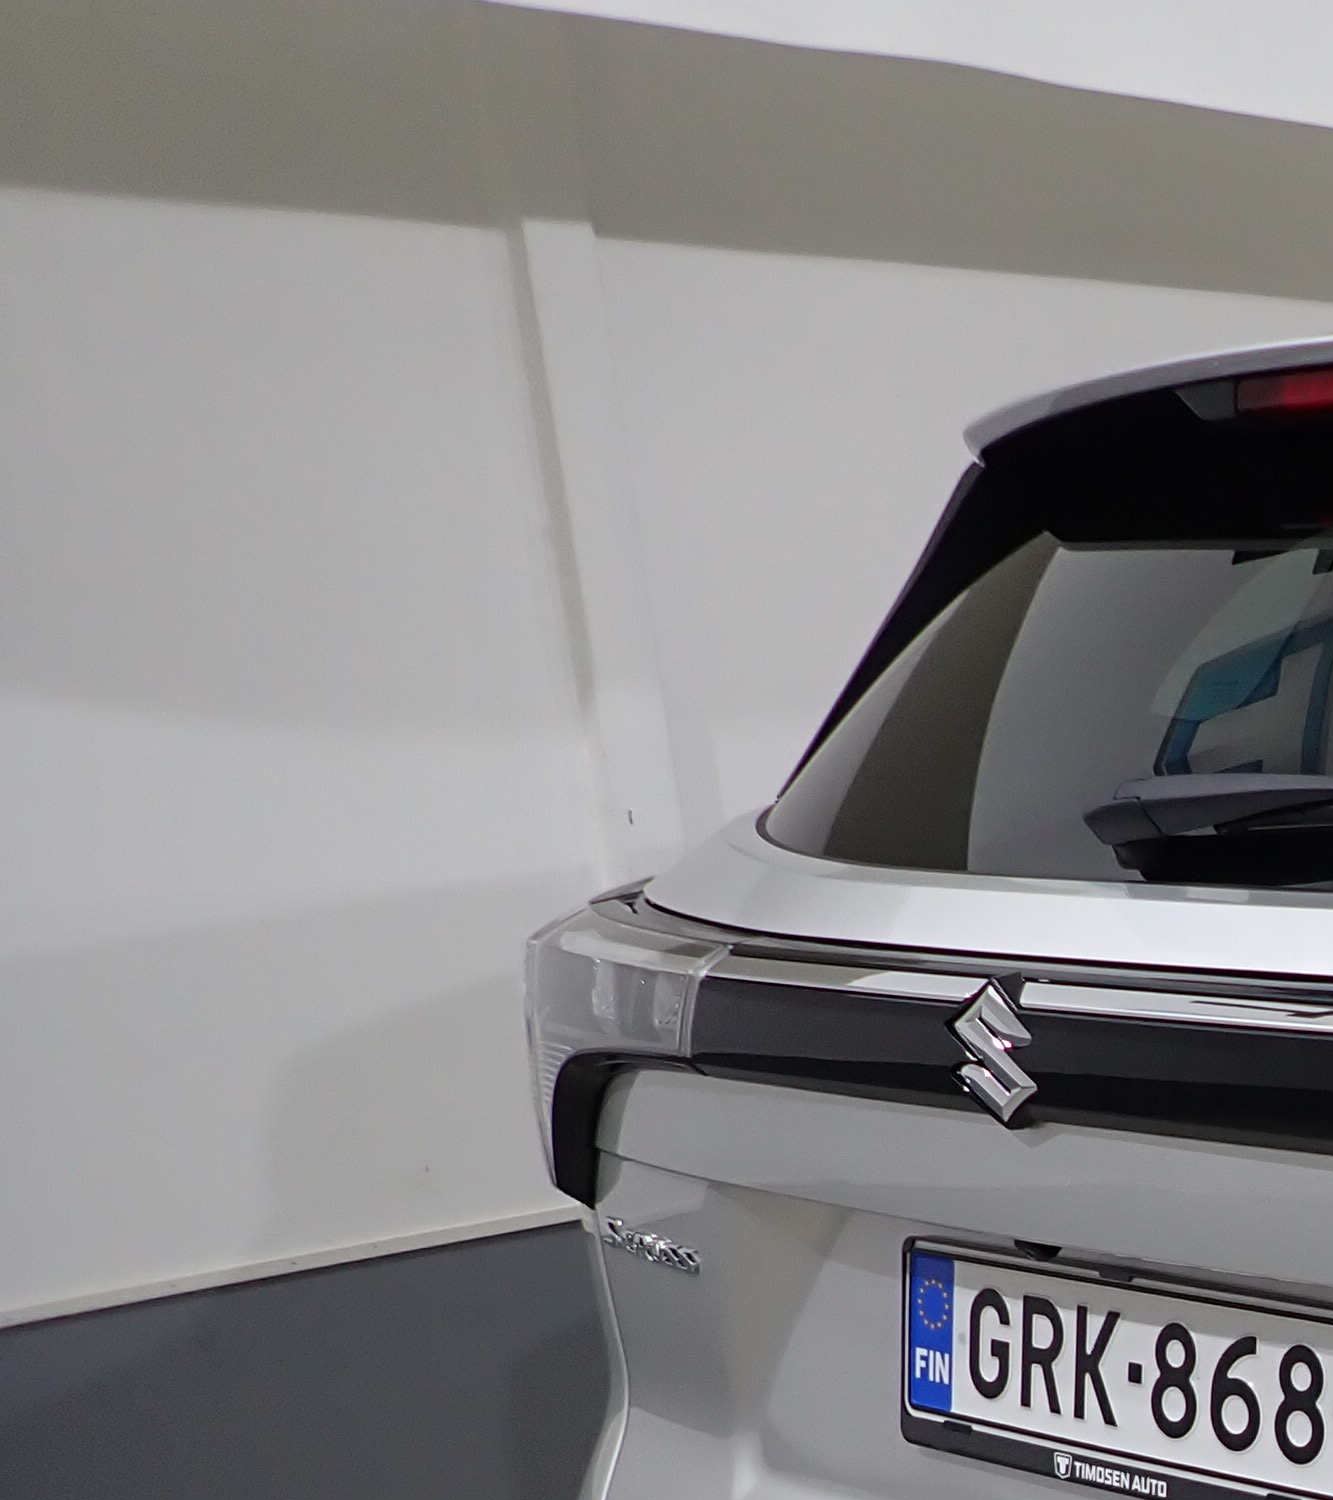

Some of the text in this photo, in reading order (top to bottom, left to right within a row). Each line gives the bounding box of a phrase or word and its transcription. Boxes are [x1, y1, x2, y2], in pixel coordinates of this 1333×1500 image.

[914, 1346, 951, 1386] FIN
[968, 1287, 1325, 1465] GRK-868
[1073, 1461, 1131, 1490] TIMOSEN
[1131, 1473, 1168, 1498] AUTO
